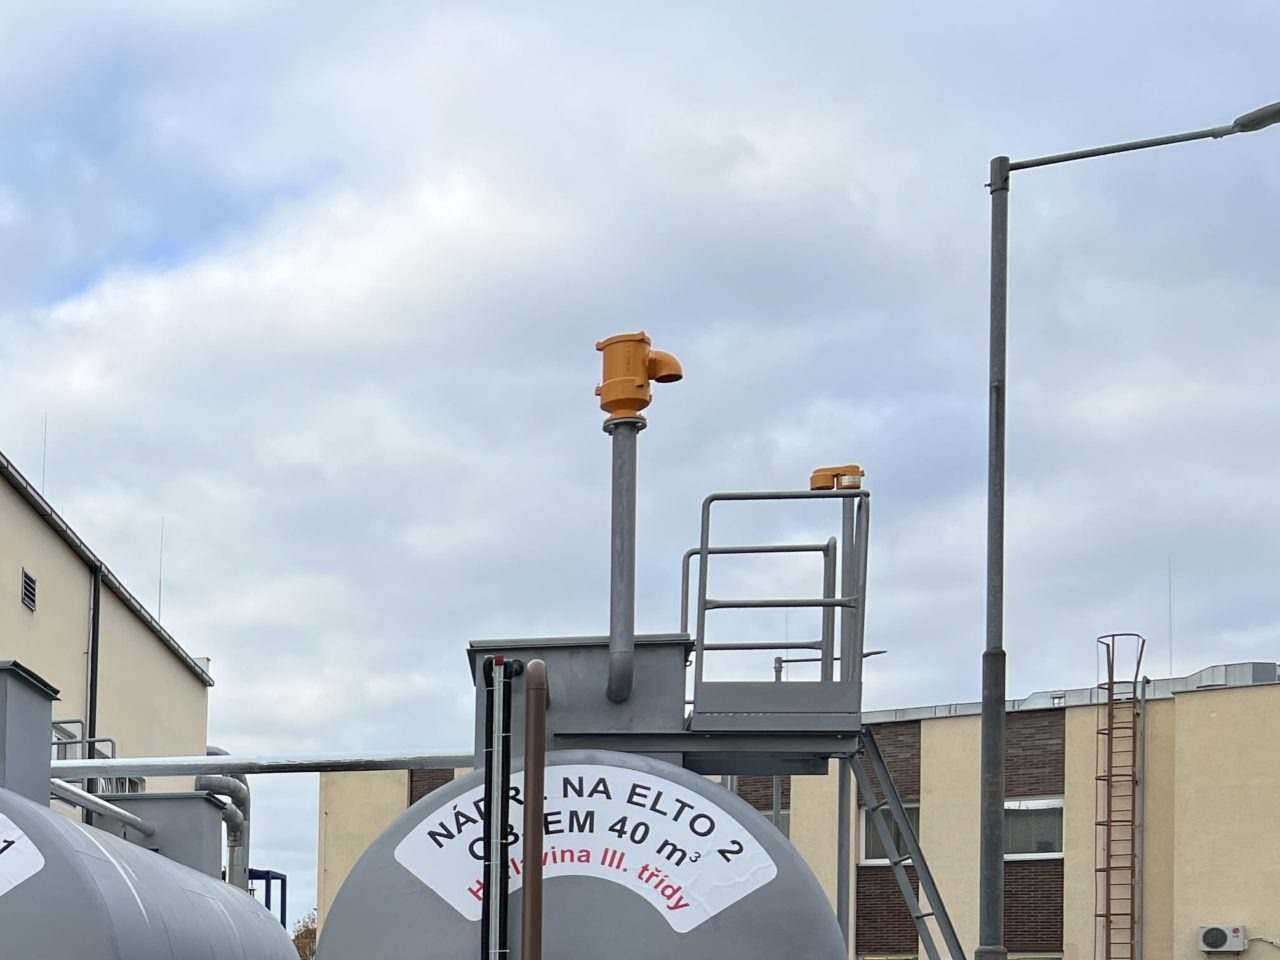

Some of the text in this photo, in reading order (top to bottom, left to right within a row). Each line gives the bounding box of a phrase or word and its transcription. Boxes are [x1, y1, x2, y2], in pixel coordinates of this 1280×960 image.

[468, 810, 595, 861] OBEM
[608, 816, 650, 844] 40
[563, 776, 612, 800] NA
[627, 783, 716, 837] ELTO
[717, 840, 744, 863] 2
[467, 846, 591, 901] Hlvina
[637, 863, 690, 911] třídy
